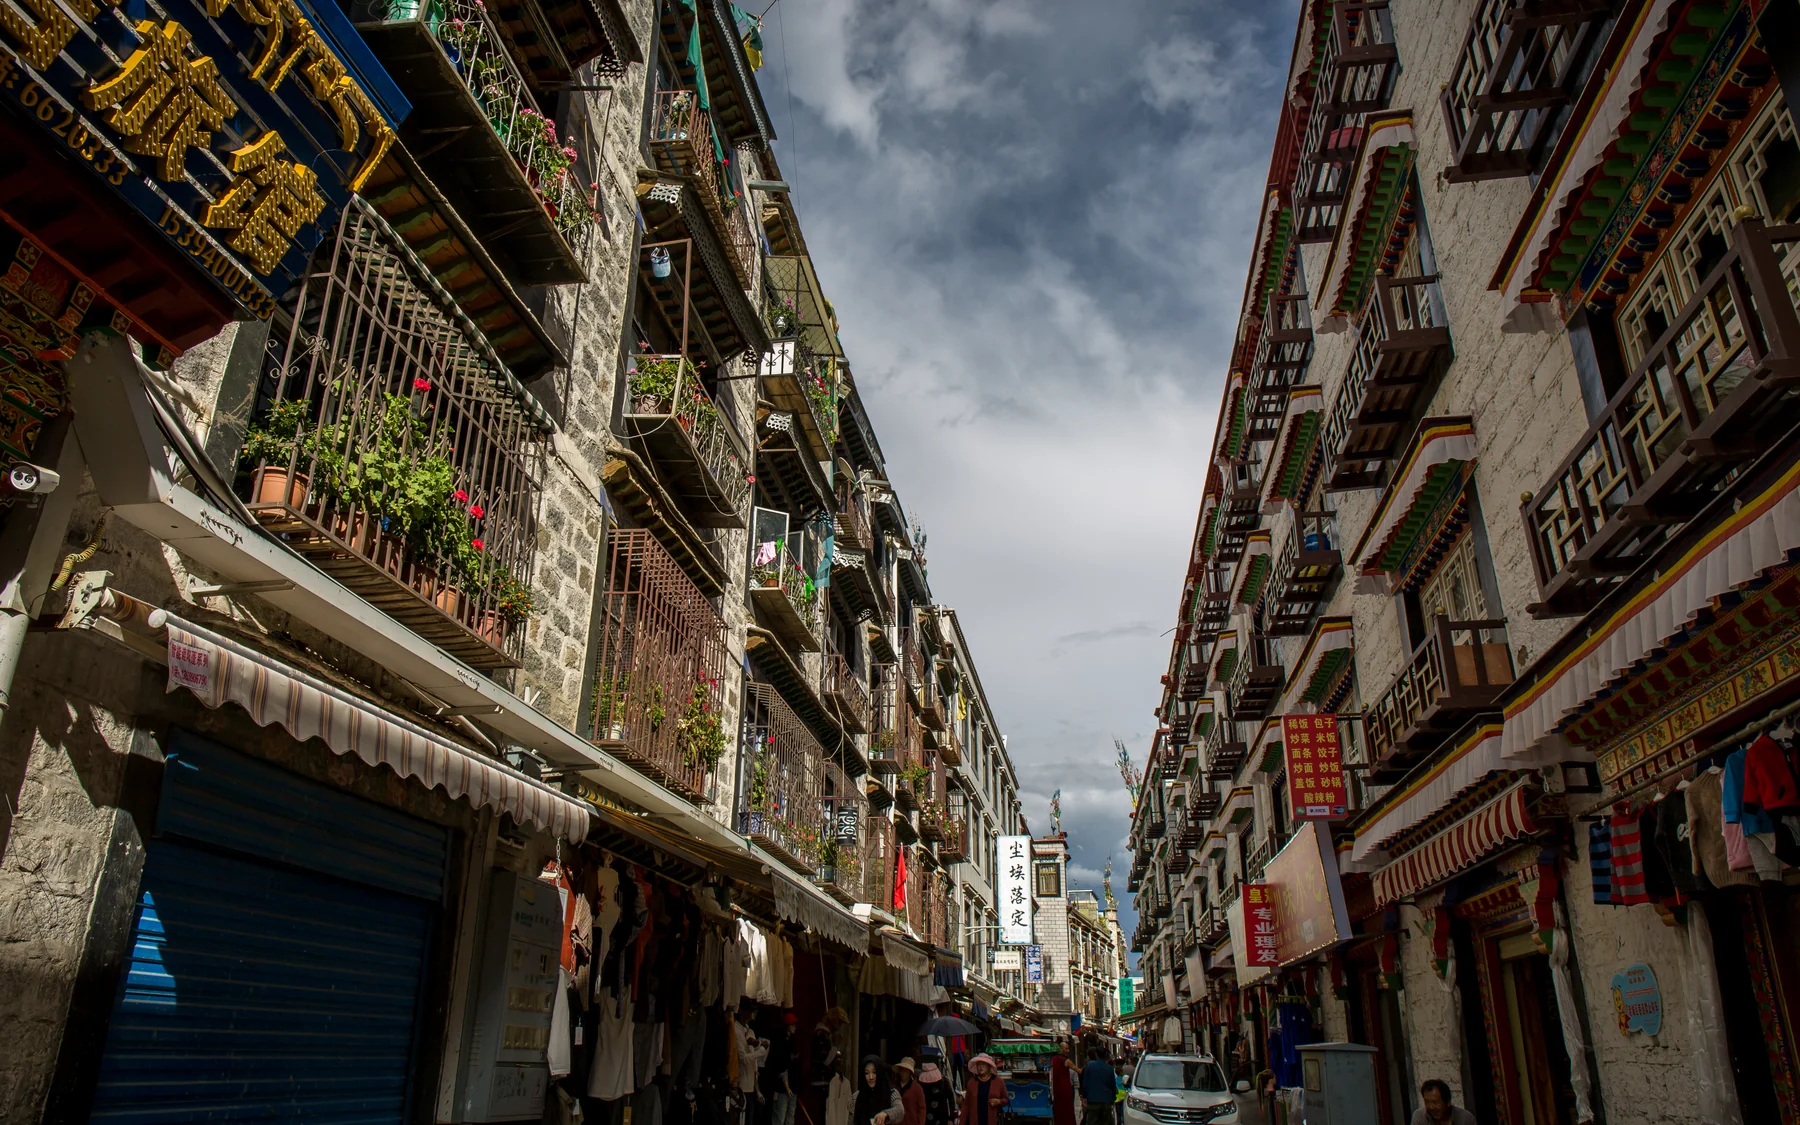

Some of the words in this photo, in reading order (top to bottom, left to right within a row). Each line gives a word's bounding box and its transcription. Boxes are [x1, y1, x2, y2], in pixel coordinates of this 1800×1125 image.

[157, 204, 276, 319] 15394001333
[1288, 718, 1309, 730] 稀饭
[1314, 717, 1334, 729] 包子
[1289, 732, 1310, 744] 炒菜
[1315, 732, 1336, 744] 米饭
[1291, 747, 1312, 759] 面条
[1317, 747, 1338, 758] 饺子
[1293, 762, 1313, 774] 炒面
[1319, 761, 1340, 773] 炒饭
[1295, 777, 1316, 789] 盖饭
[1320, 776, 1342, 788] 砂锅
[1303, 792, 1335, 804] 酸辣粉
[1008, 841, 1029, 927] 尘埃落定
[1253, 907, 1278, 963] 专业理发
